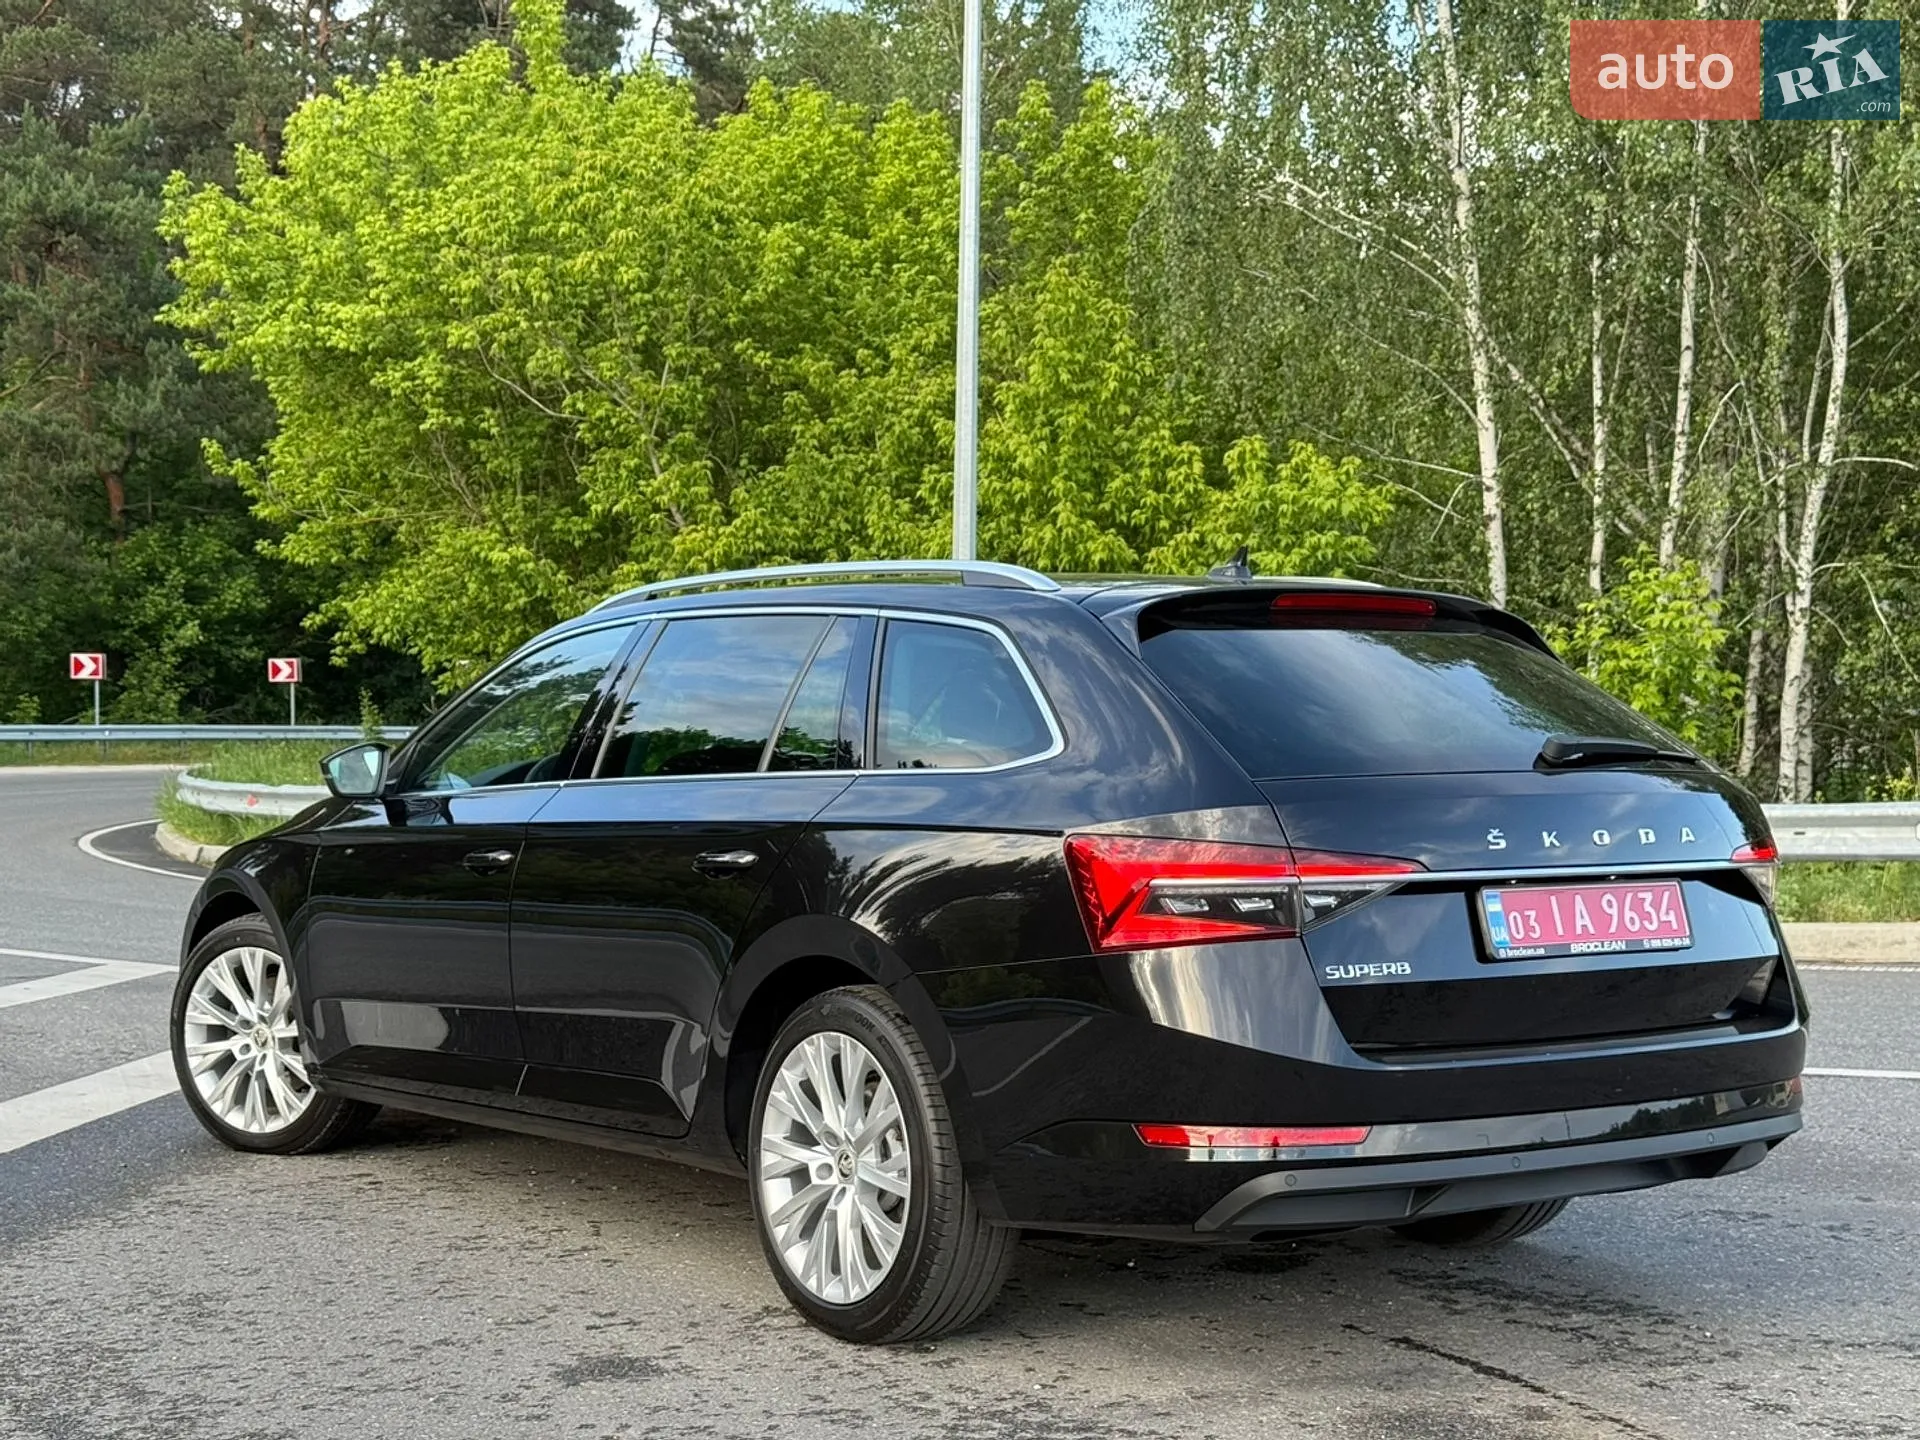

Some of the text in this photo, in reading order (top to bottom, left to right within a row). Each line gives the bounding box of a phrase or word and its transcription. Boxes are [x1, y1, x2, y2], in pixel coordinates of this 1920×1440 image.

[1486, 828, 1696, 850] ŠKODA
[1491, 926, 1509, 942] UA
[1508, 910, 1541, 940] 03
[1570, 940, 1626, 953] BROCLEAN
[1325, 961, 1412, 979] SUPERB
